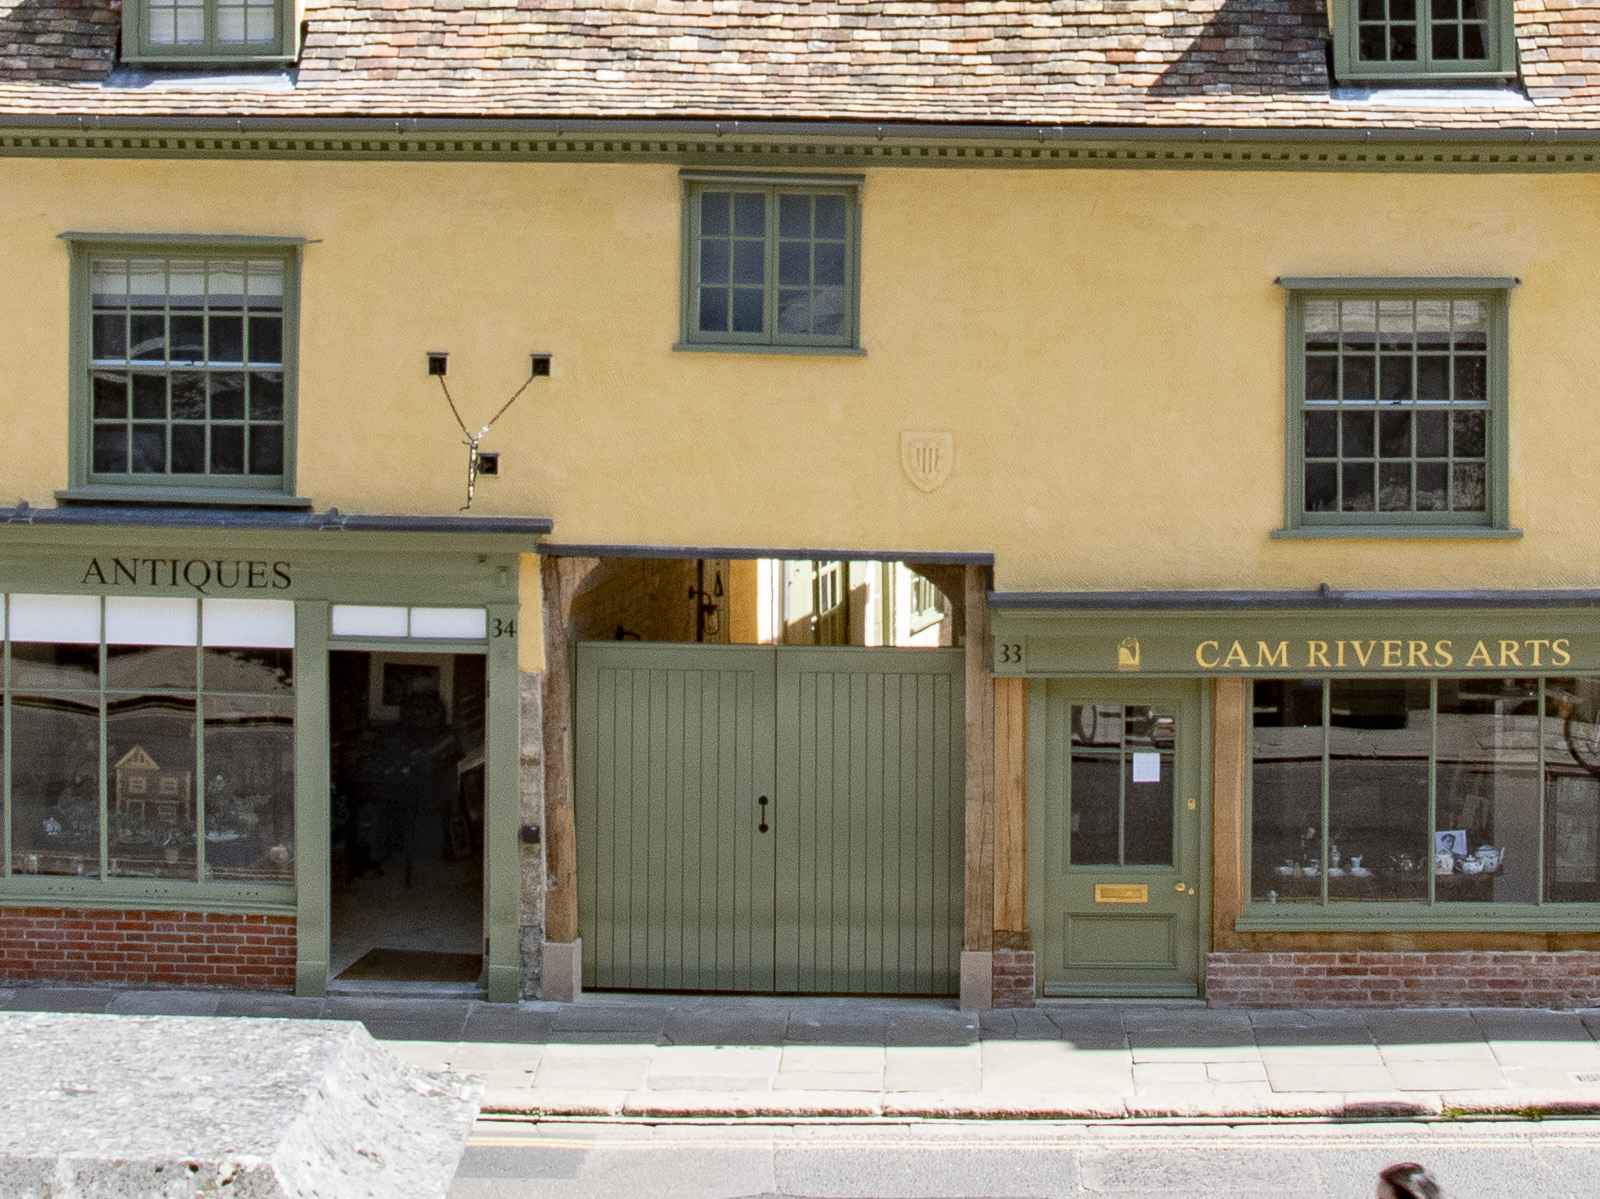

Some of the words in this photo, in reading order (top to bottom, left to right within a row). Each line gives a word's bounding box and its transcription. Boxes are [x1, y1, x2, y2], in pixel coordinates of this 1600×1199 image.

[81, 558, 292, 593] ANTIQUES
[492, 618, 517, 638] 34
[999, 644, 1022, 664] 33
[1195, 640, 1290, 668] CAM
[1306, 639, 1454, 668] RIVERS
[1468, 638, 1572, 667] ARTS
